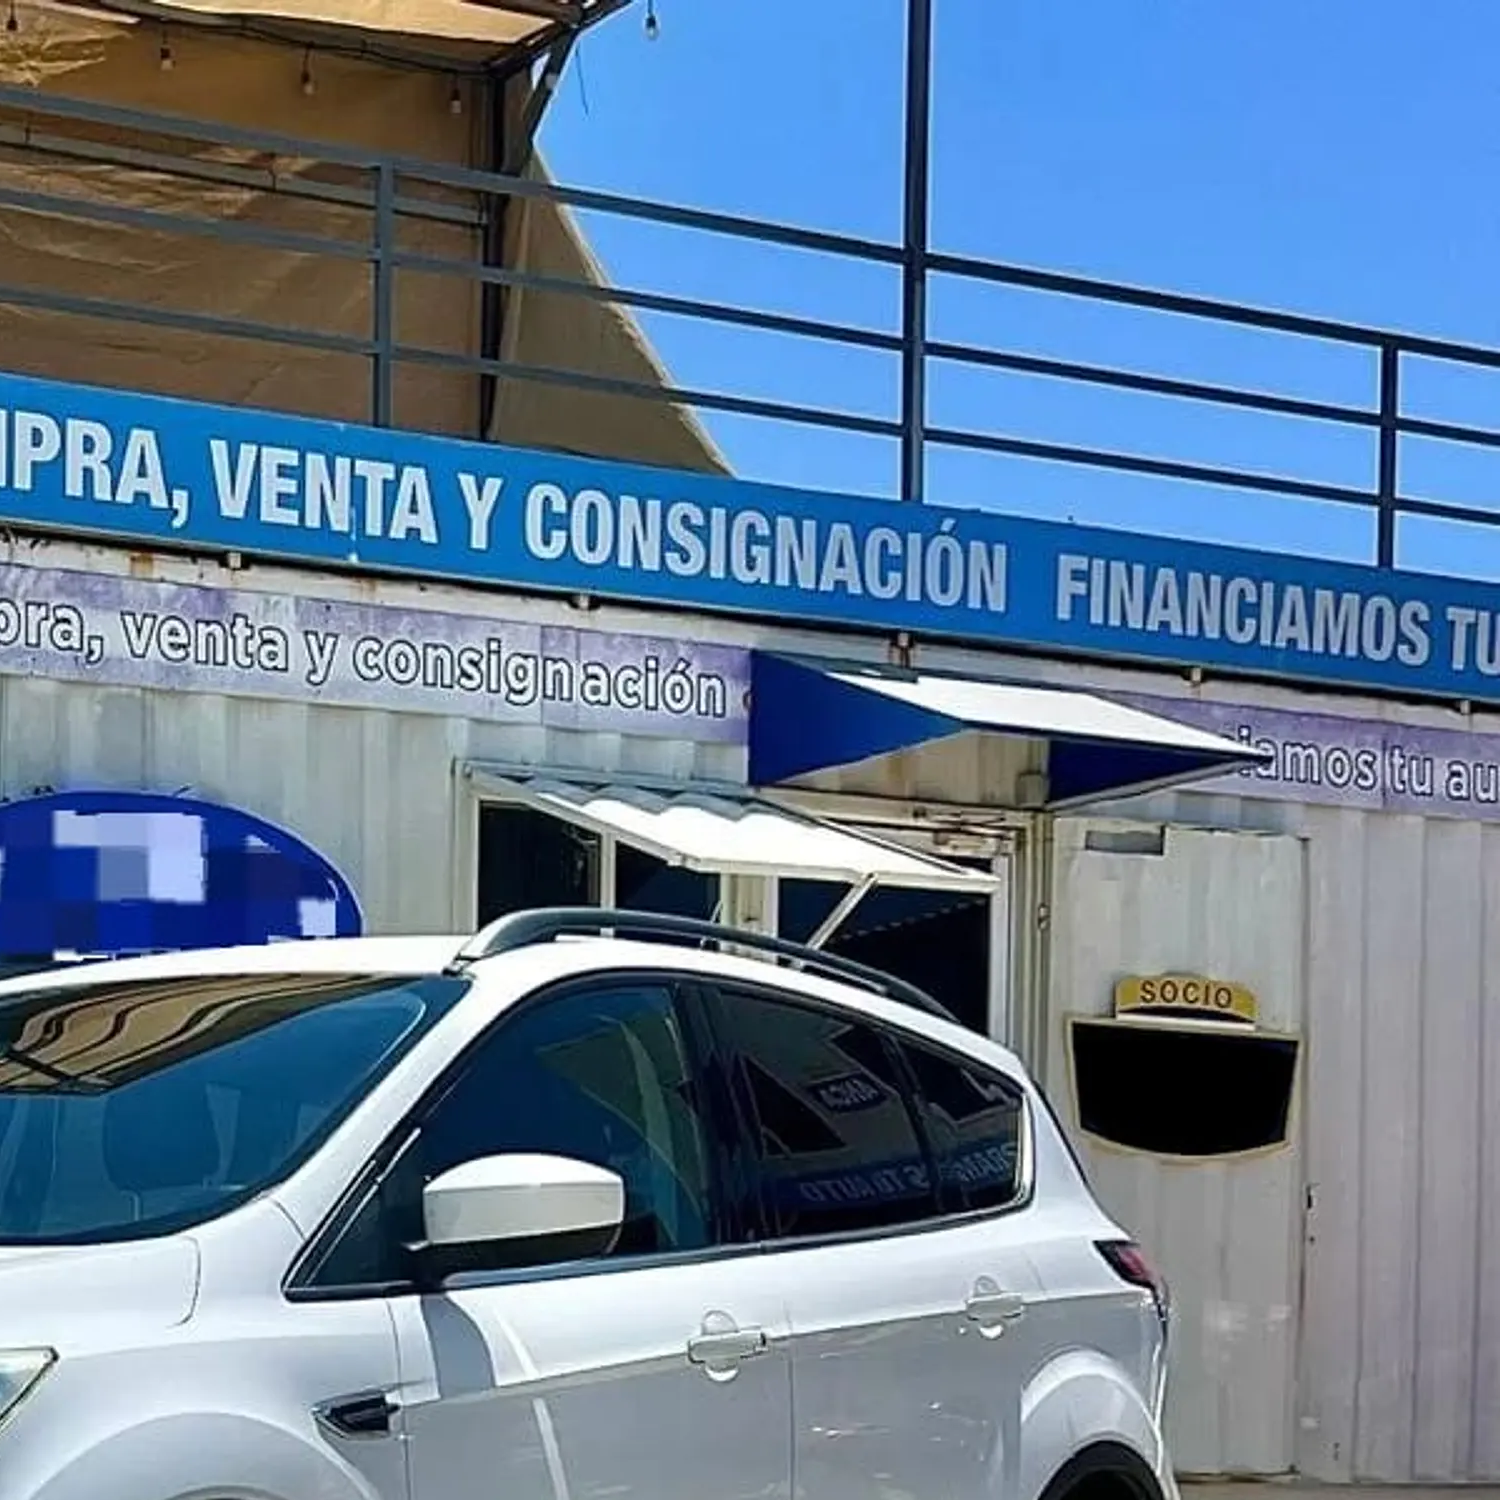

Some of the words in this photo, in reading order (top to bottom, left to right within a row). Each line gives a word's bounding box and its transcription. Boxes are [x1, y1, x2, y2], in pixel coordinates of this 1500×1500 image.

[209, 438, 439, 545] VENTA
[457, 472, 502, 551] Y
[525, 482, 1008, 613] CONSIGNACIÓN
[1056, 553, 1432, 667] FINANCIAMOS
[1445, 606, 1500, 676] TU
[120, 606, 289, 672] venta
[302, 628, 340, 686] y
[352, 634, 727, 718] consignación
[1389, 744, 1434, 797] tu
[1139, 979, 1233, 1009] SOCIO
